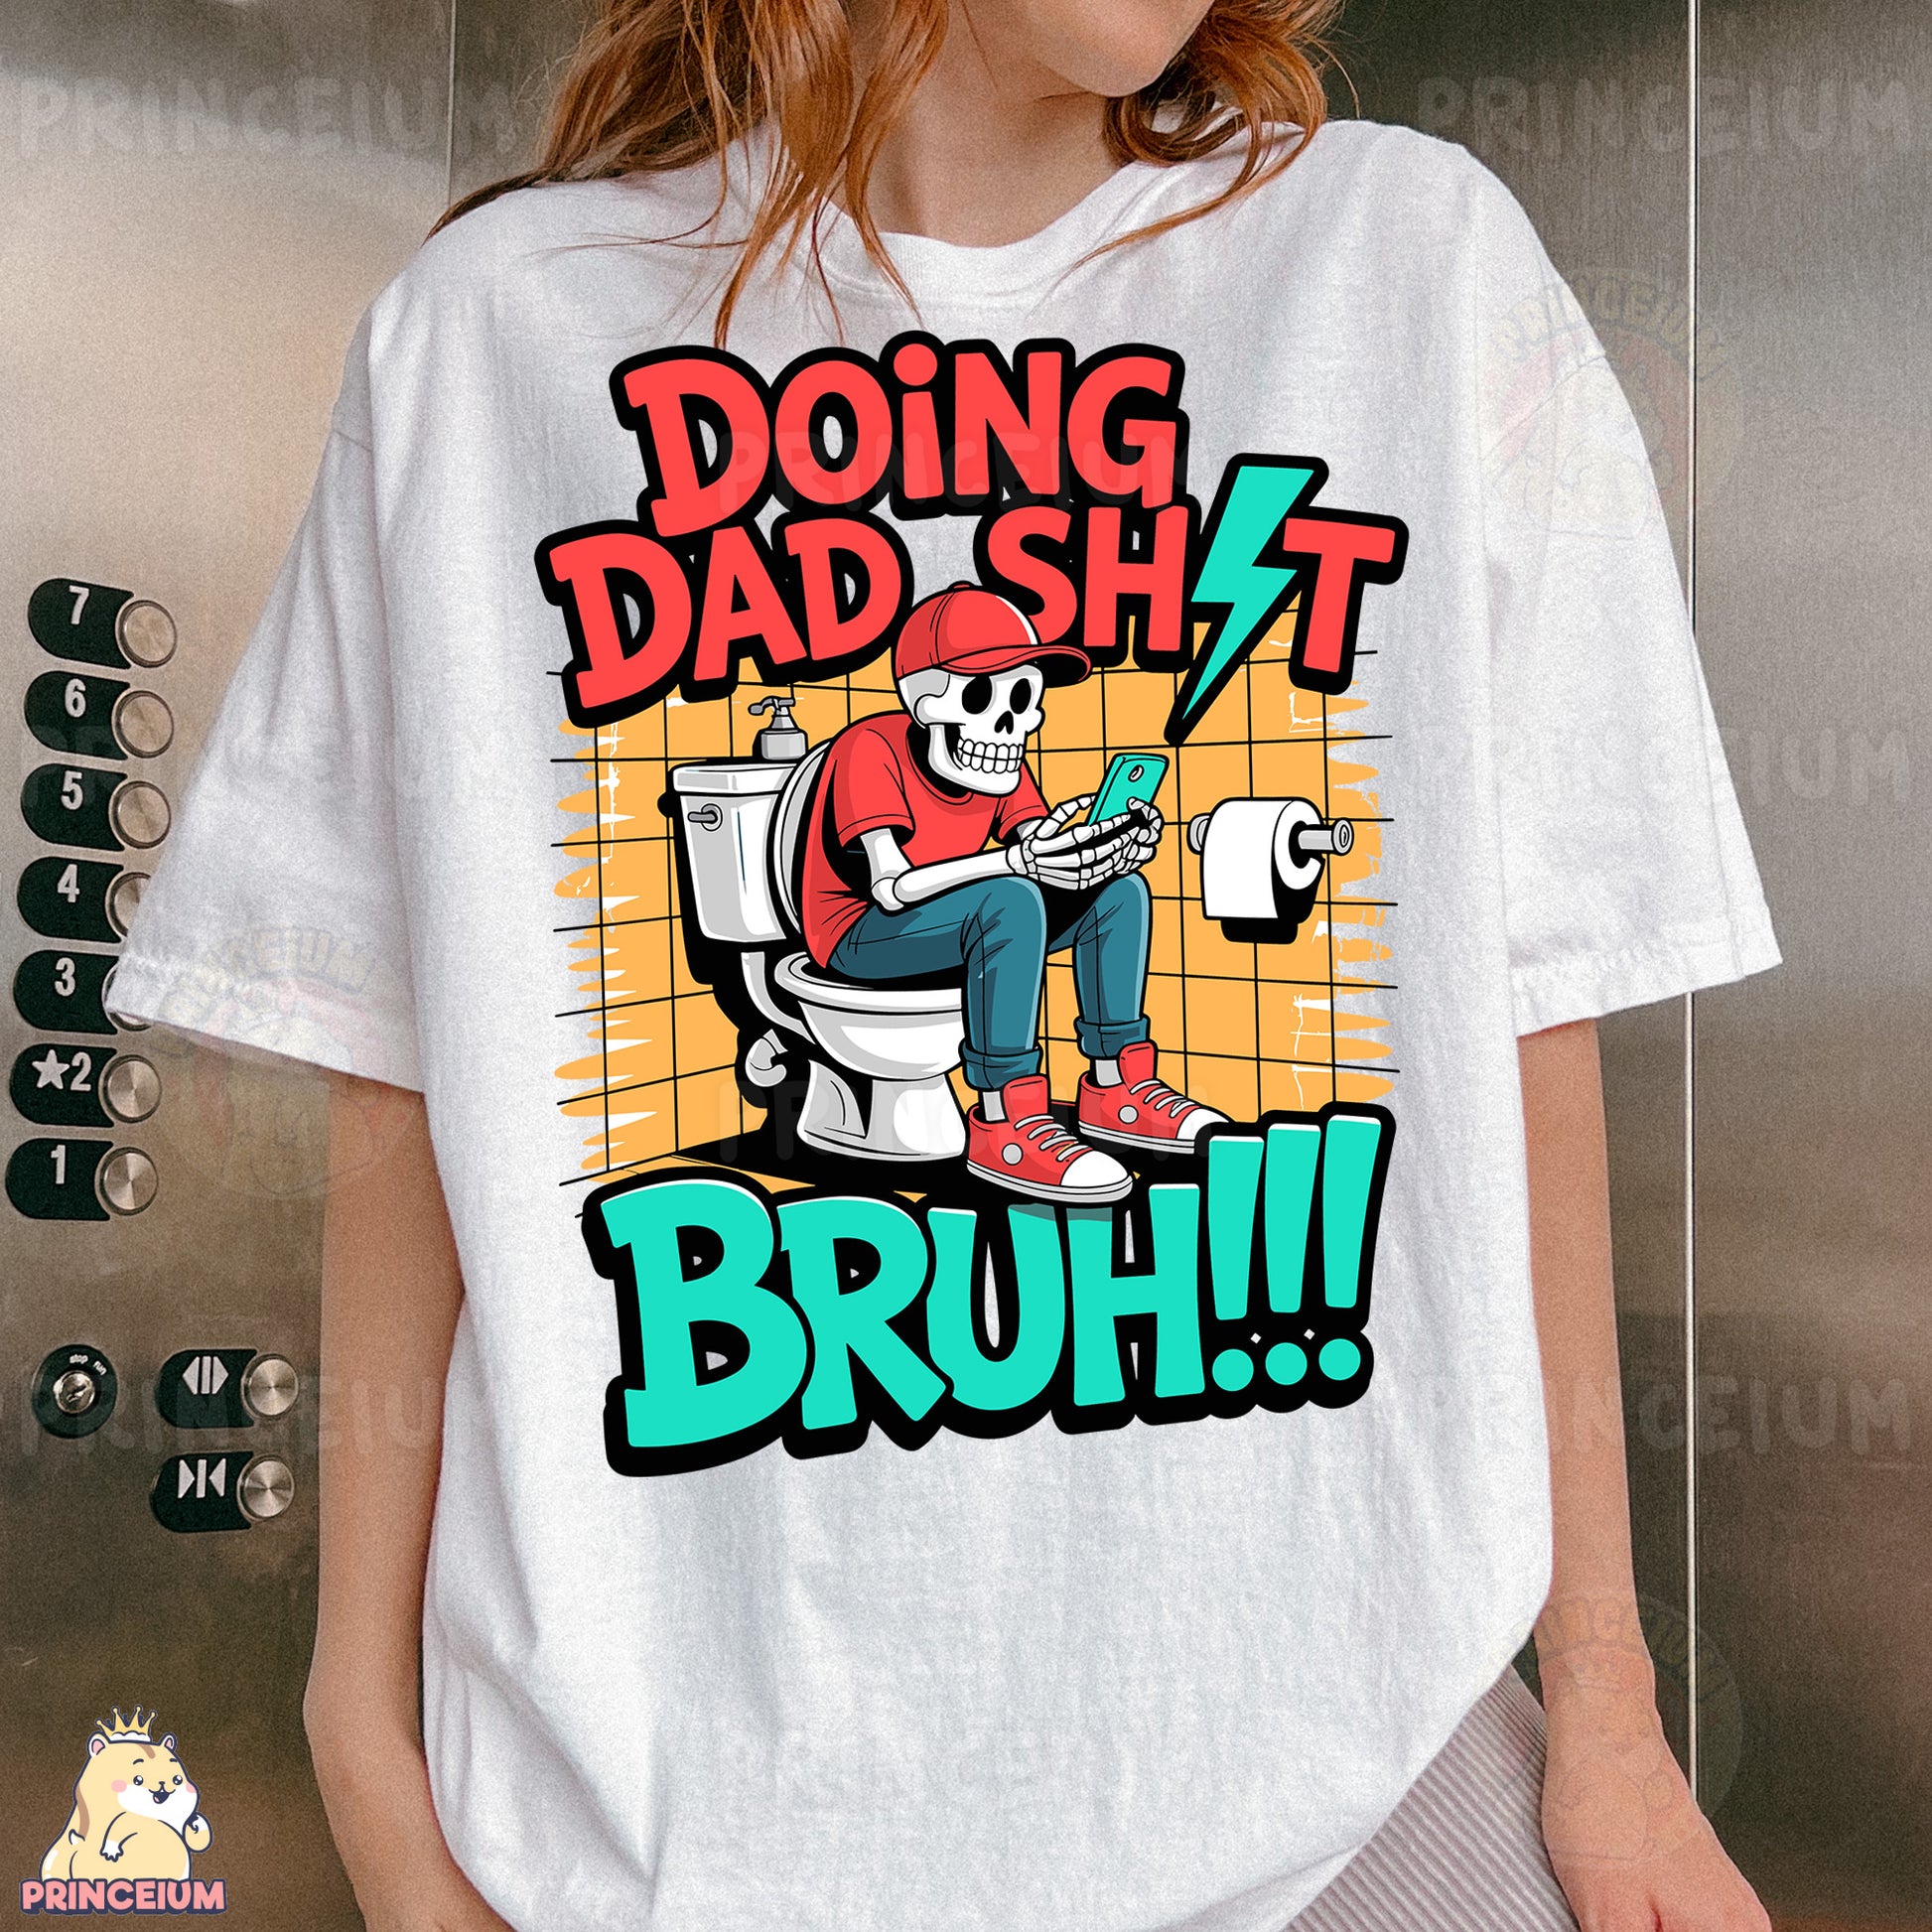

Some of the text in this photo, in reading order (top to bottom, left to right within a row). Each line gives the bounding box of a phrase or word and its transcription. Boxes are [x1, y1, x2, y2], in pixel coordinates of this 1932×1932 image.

[69, 585, 90, 625] 7
[548, 517, 902, 708] DAD
[64, 678, 87, 719] 6
[61, 769, 84, 811] 5
[57, 863, 80, 903] 4
[54, 956, 76, 997] 3
[50, 1144, 68, 1184] 1
[600, 1114, 1383, 1449] BRUH!!!
[69, 1353, 108, 1377] stop run
